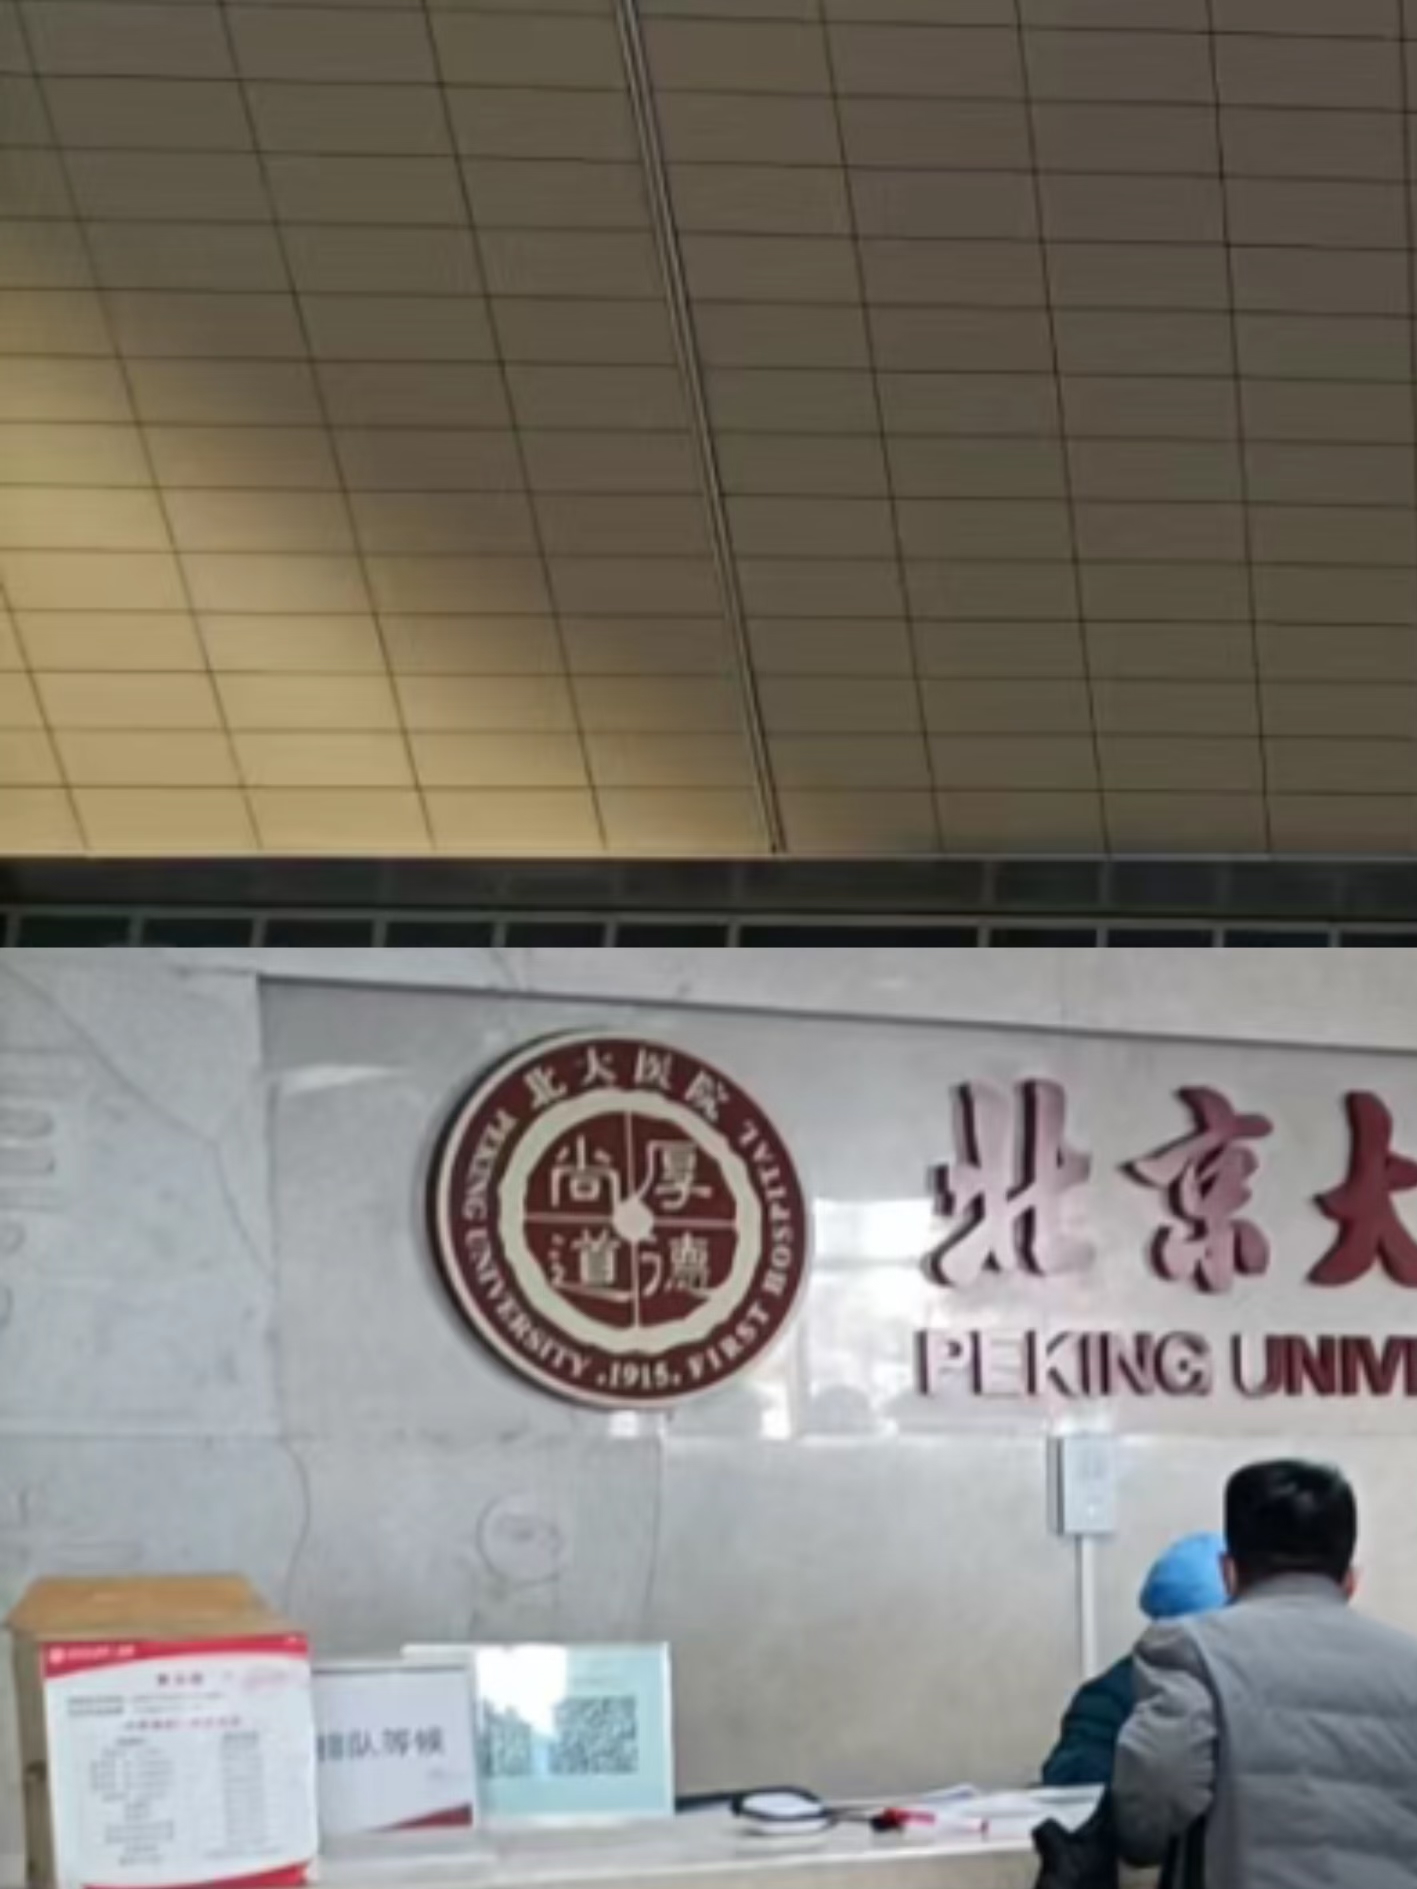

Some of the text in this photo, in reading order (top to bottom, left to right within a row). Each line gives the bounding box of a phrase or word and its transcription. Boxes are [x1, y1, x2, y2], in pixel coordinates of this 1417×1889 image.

[463, 1109, 595, 1379] PEKING UNIVERSITY
[687, 1119, 794, 1381] FIRST HOSPITAL
[915, 1329, 1210, 1398] PEKING
